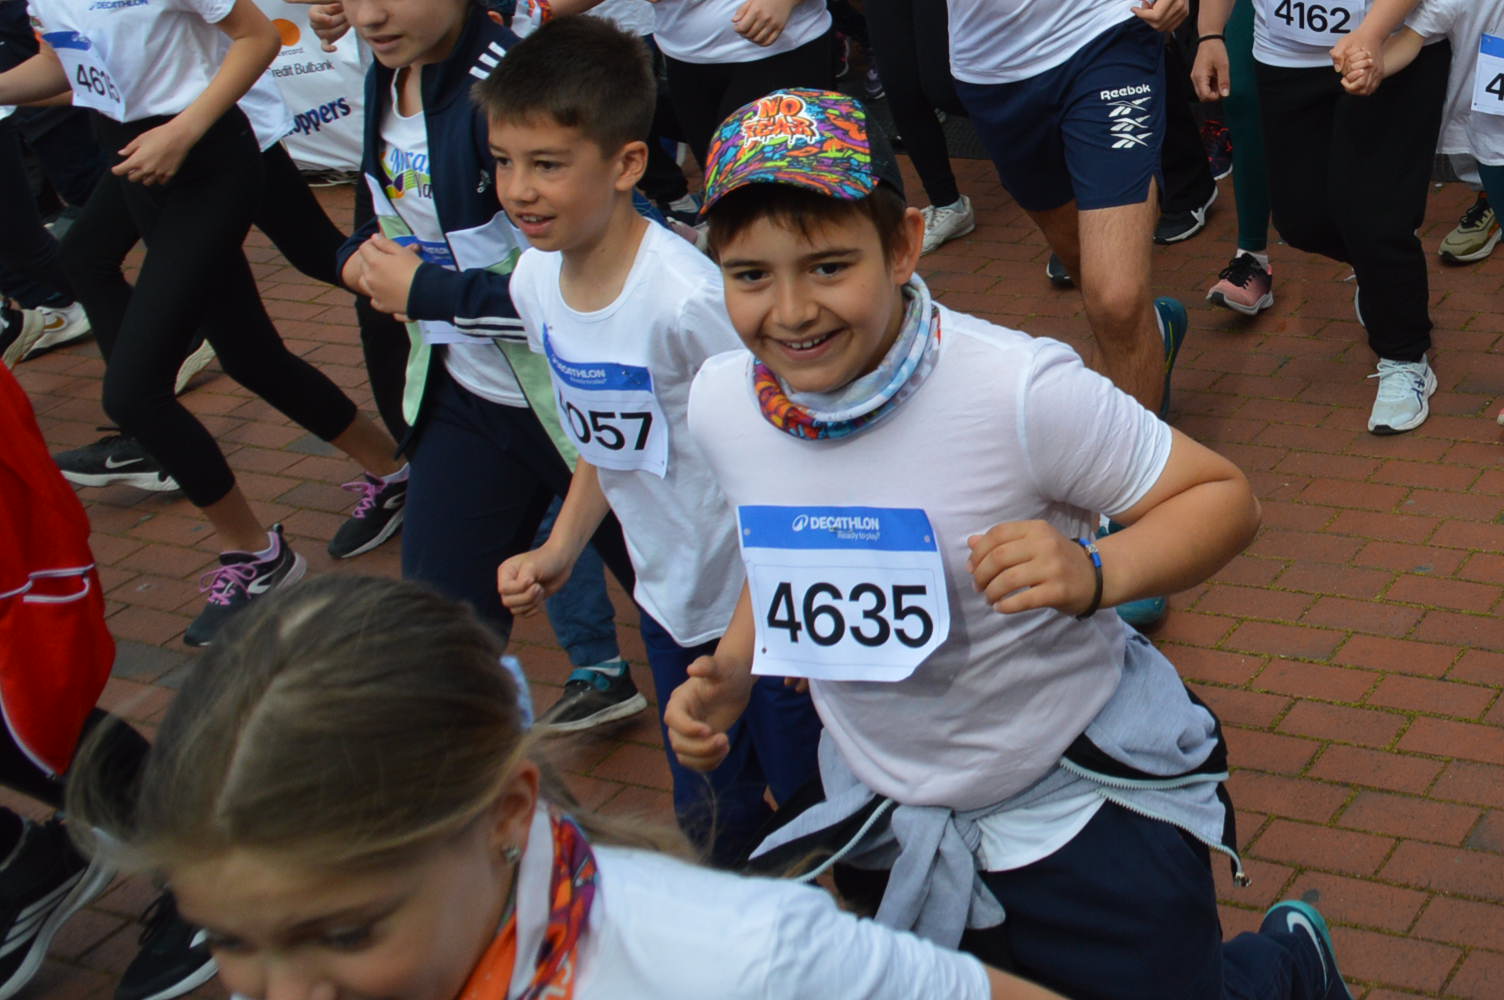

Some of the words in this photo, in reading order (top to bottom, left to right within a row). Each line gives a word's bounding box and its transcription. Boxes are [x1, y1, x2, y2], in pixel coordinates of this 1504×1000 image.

[270, 64, 294, 79] redit
[295, 60, 335, 76] Bulbank
[1100, 84, 1151, 100] Reebok
[757, 95, 805, 118] NO
[743, 116, 817, 137] FEAR
[560, 396, 653, 451] 057
[810, 516, 880, 530] DECATHLON
[767, 582, 934, 648] 4635
